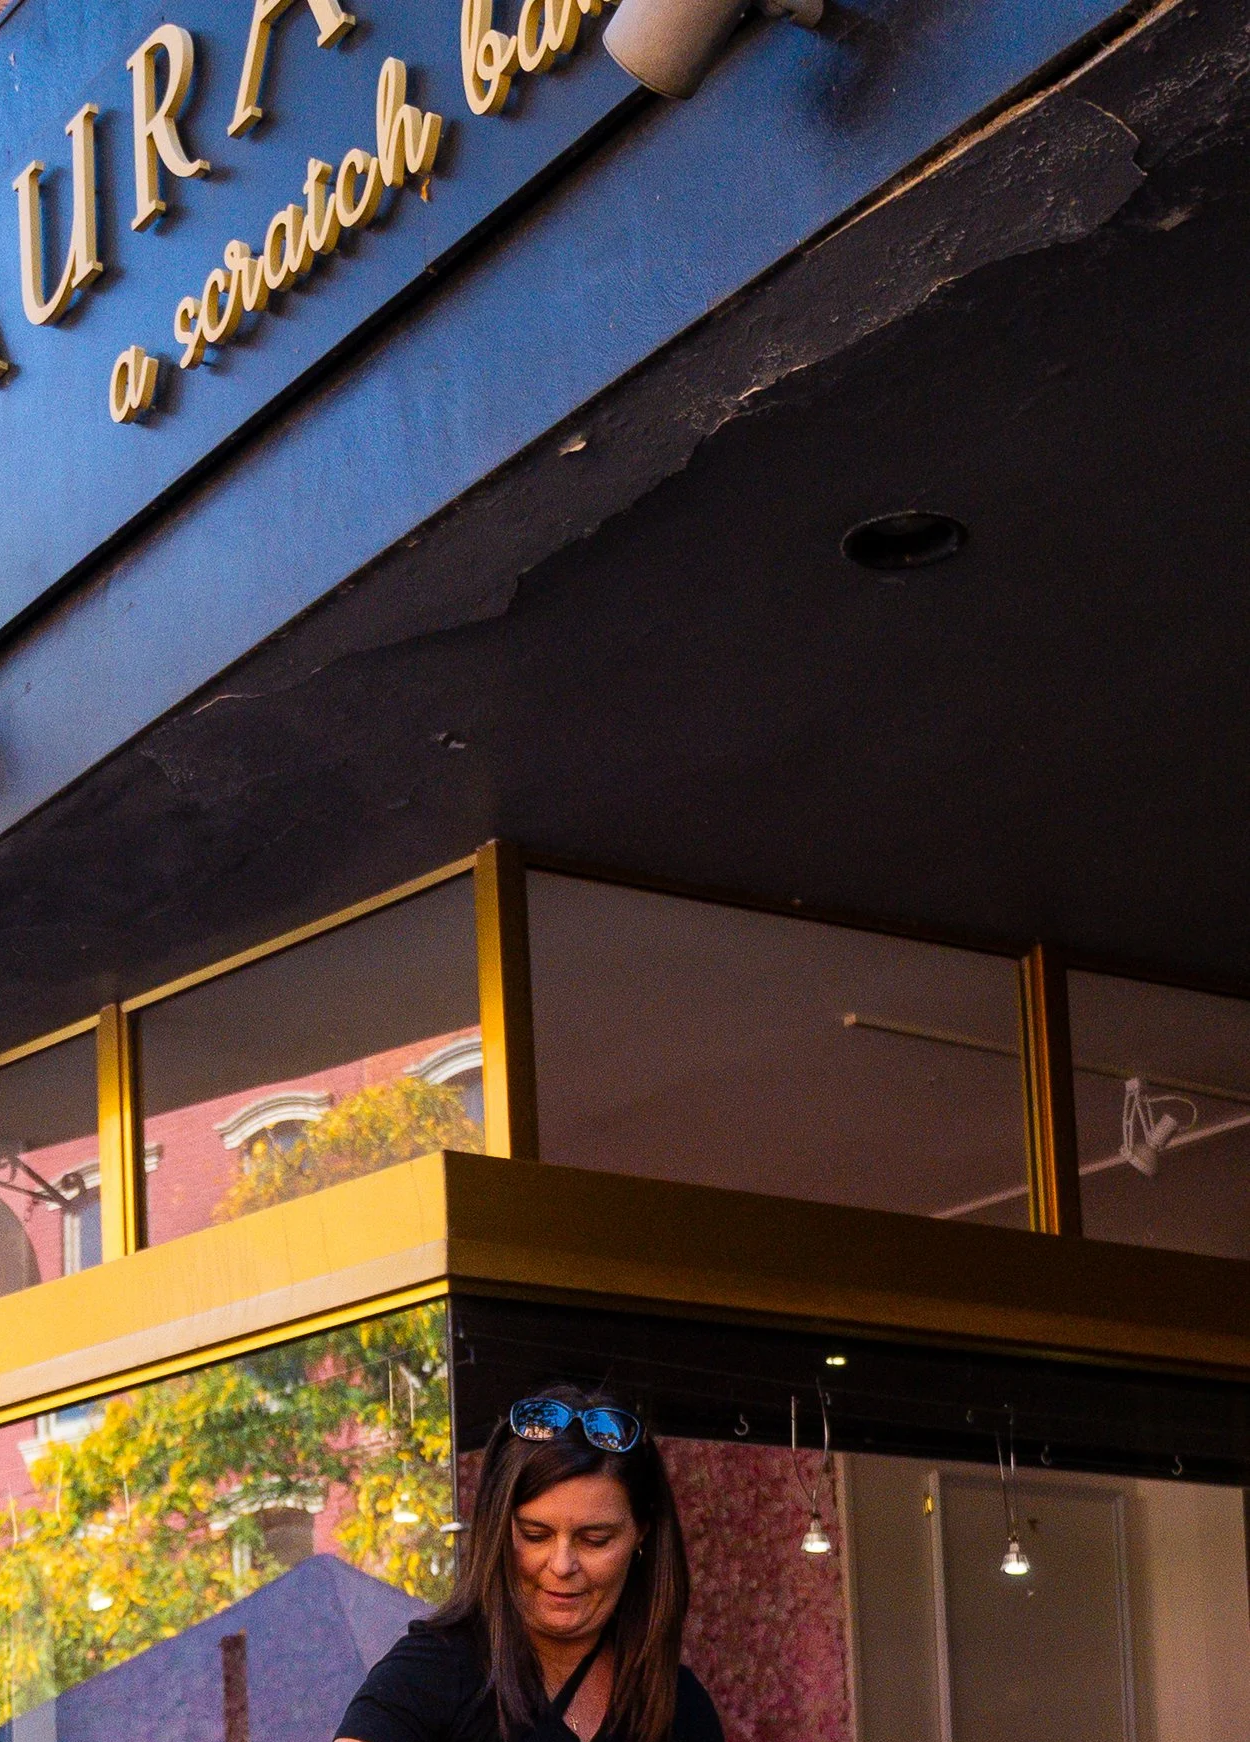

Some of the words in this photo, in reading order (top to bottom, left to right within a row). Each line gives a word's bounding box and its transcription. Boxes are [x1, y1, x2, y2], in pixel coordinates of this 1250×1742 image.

[109, 345, 159, 424] a
[174, 57, 442, 369] scratch
[460, 0, 608, 115] ba
